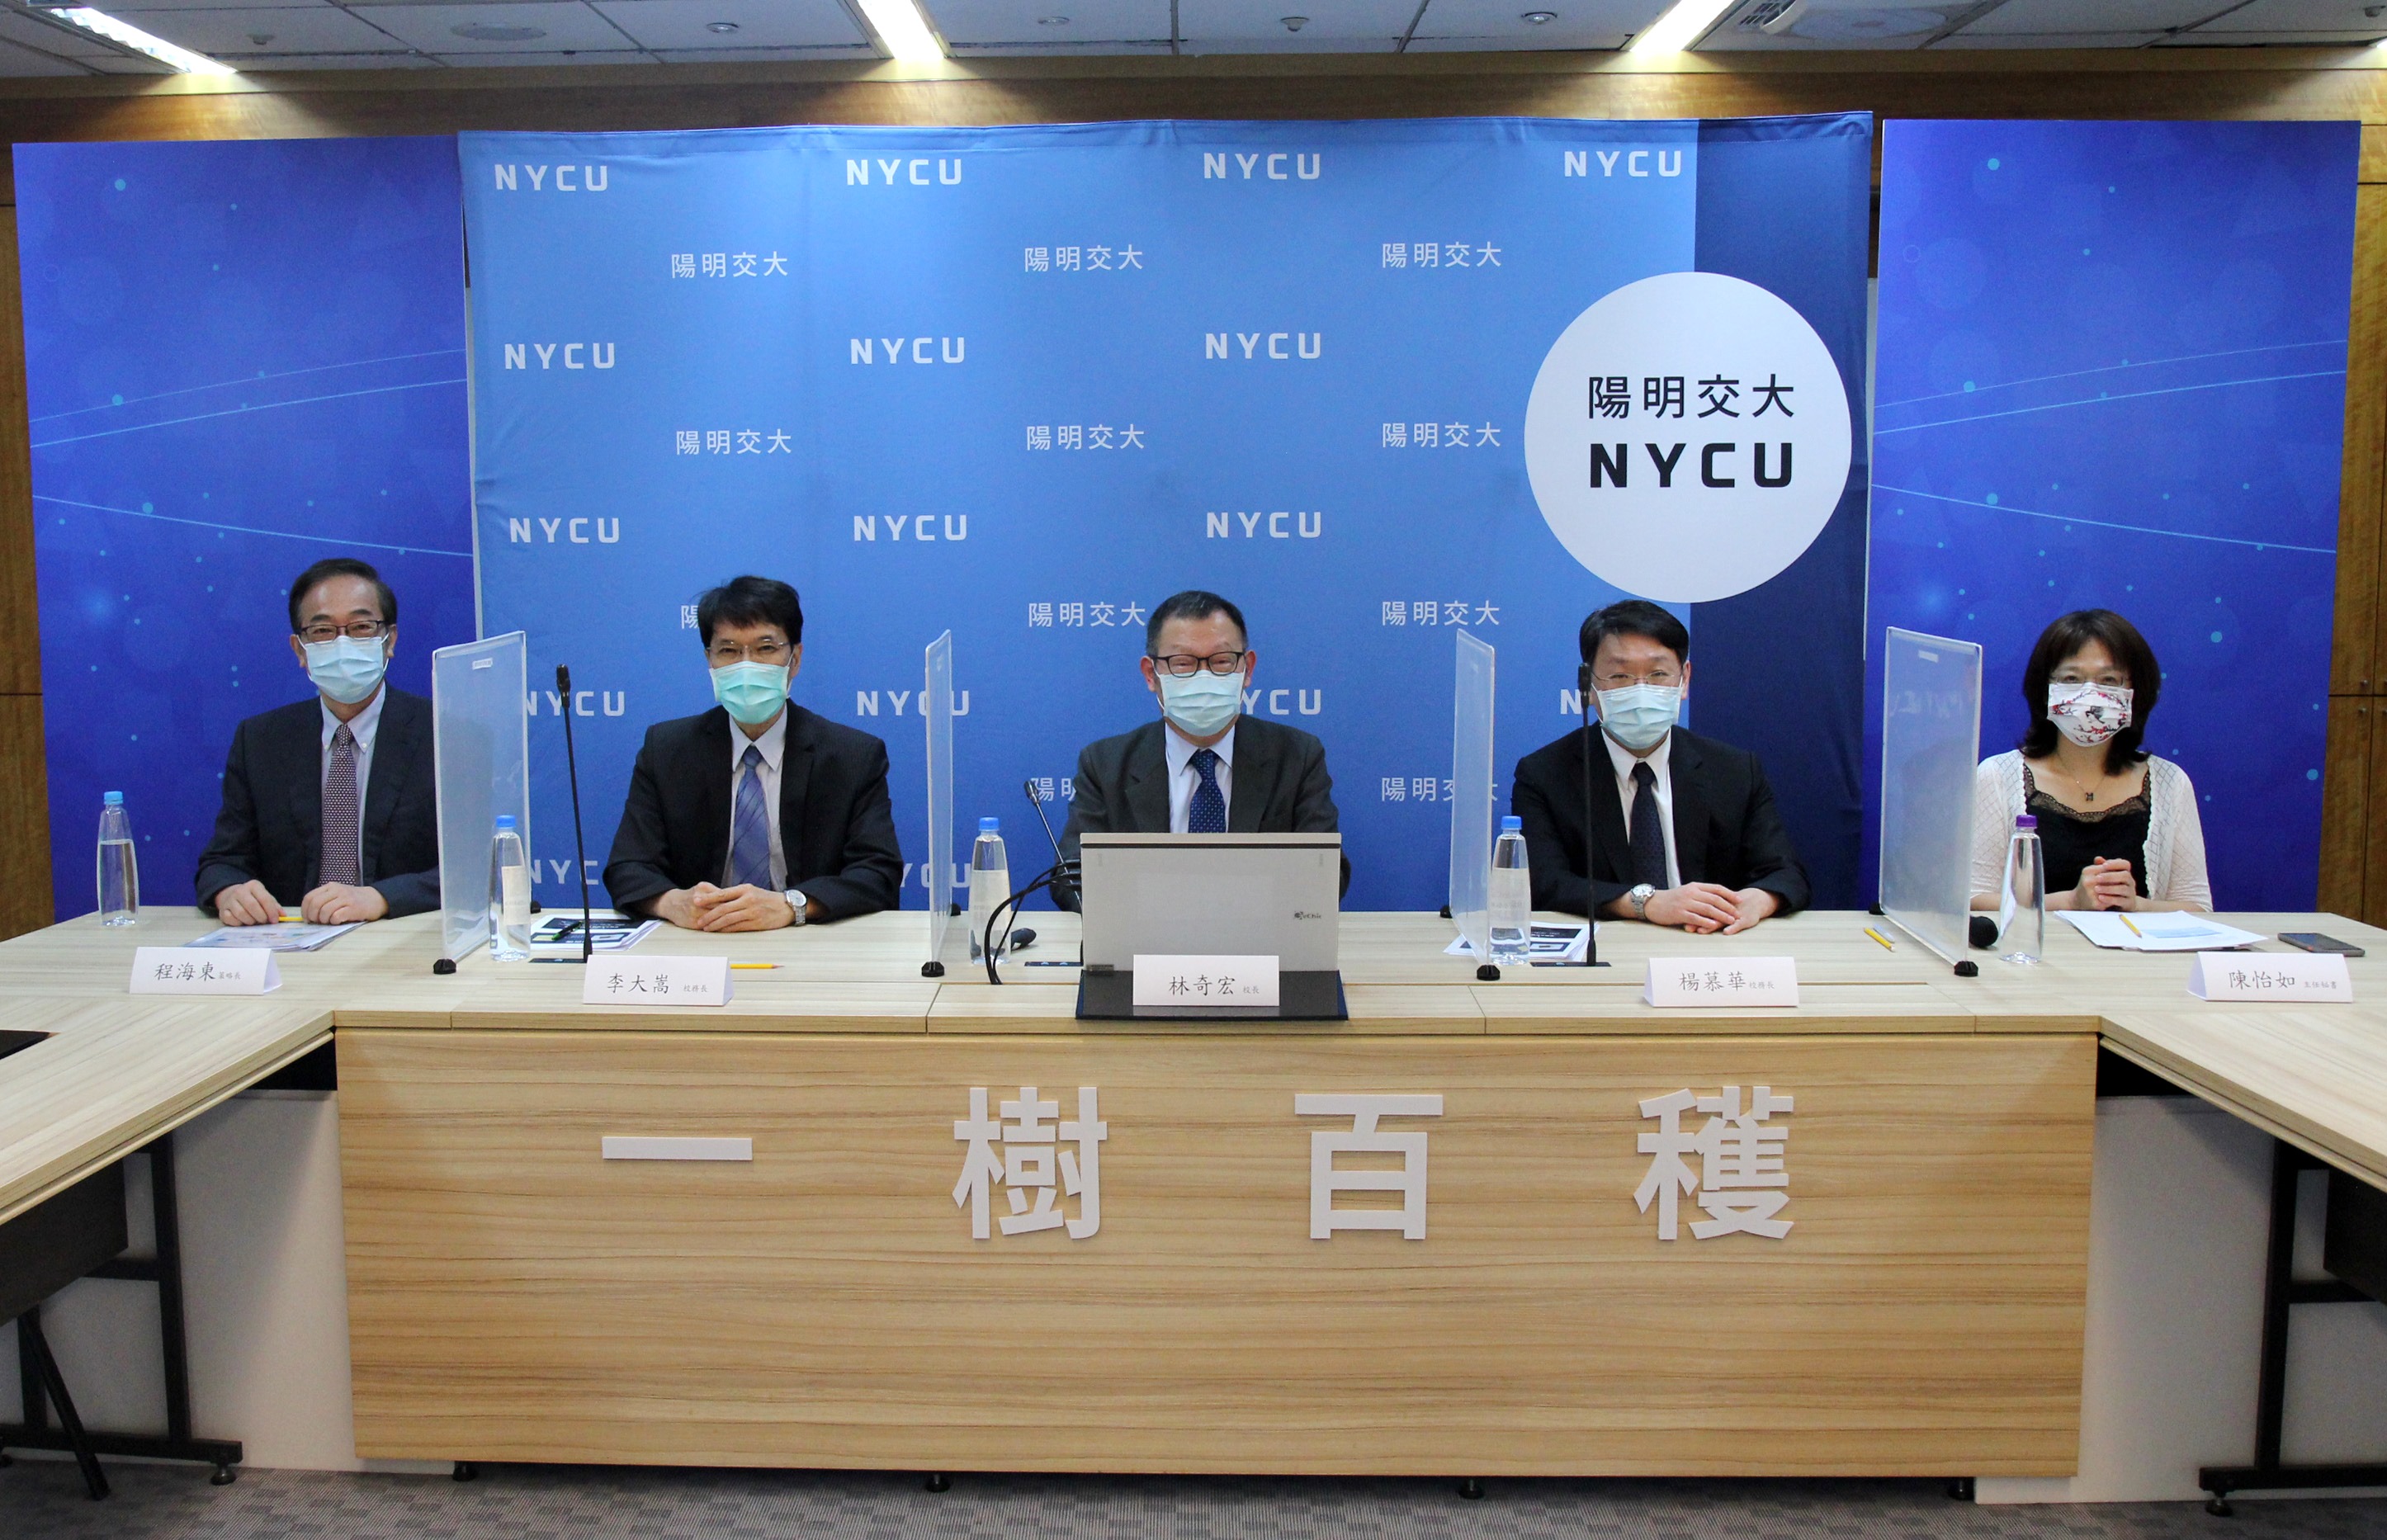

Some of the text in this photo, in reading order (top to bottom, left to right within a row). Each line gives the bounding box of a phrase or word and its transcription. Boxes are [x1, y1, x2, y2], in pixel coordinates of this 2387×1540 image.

[847, 159, 962, 186] NYCU
[1204, 153, 1320, 179] NYCU
[1565, 150, 1681, 177] NYCU
[495, 164, 607, 191] NYCU
[672, 251, 788, 278] 陽明交大
[1025, 244, 1143, 272] 陽明交大
[1383, 242, 1501, 268] 陽明交大
[505, 342, 615, 369] NYCU
[851, 337, 965, 364] NYCU
[1205, 333, 1321, 359] NYCU
[1589, 374, 1794, 419] 陽明交大
[676, 428, 792, 455] 陽明交大
[1026, 424, 1144, 451] 陽明交大
[1382, 422, 1501, 447] 陽明交大
[1590, 442, 1793, 488] NYCU
[510, 517, 620, 544] NYCU
[853, 515, 967, 541] NYCU
[1207, 512, 1321, 538] NYCU
[1028, 602, 1146, 627] 陽明交大
[1382, 600, 1501, 626] 陽明交大
[1241, 688, 1322, 715] YCU
[154, 961, 216, 982] 程海東
[607, 973, 669, 994] 李大嵩
[1679, 971, 1747, 992] 楊慕華
[2229, 970, 2295, 990] 陳怡如
[1169, 975, 1260, 996] 林奇宏 校長
